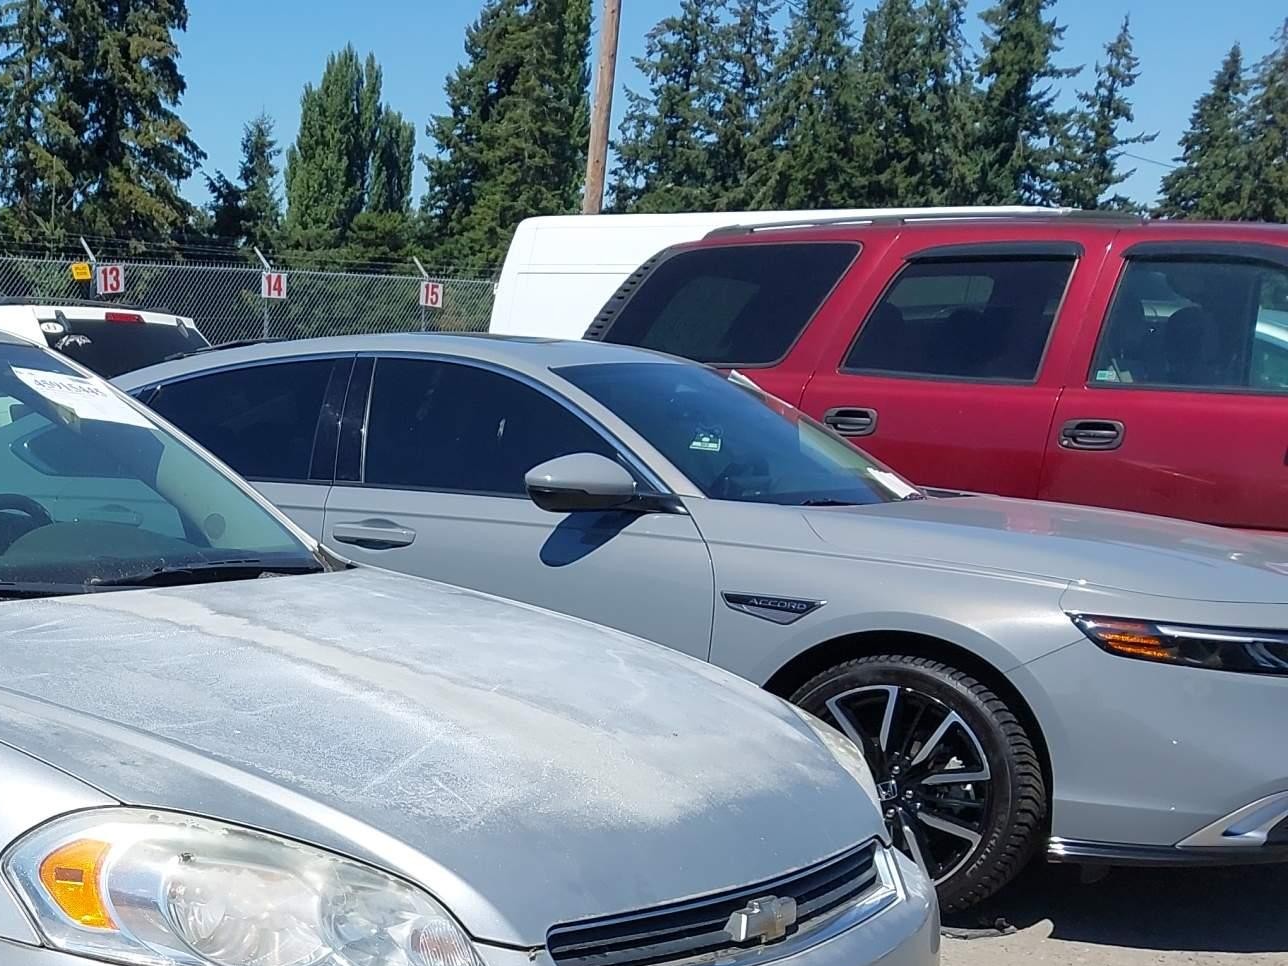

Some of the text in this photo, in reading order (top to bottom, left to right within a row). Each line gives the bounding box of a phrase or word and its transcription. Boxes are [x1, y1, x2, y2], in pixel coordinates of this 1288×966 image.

[101, 266, 121, 292] 13
[265, 273, 283, 297] 14
[424, 283, 439, 305] 15
[749, 597, 807, 610] ACCORD
